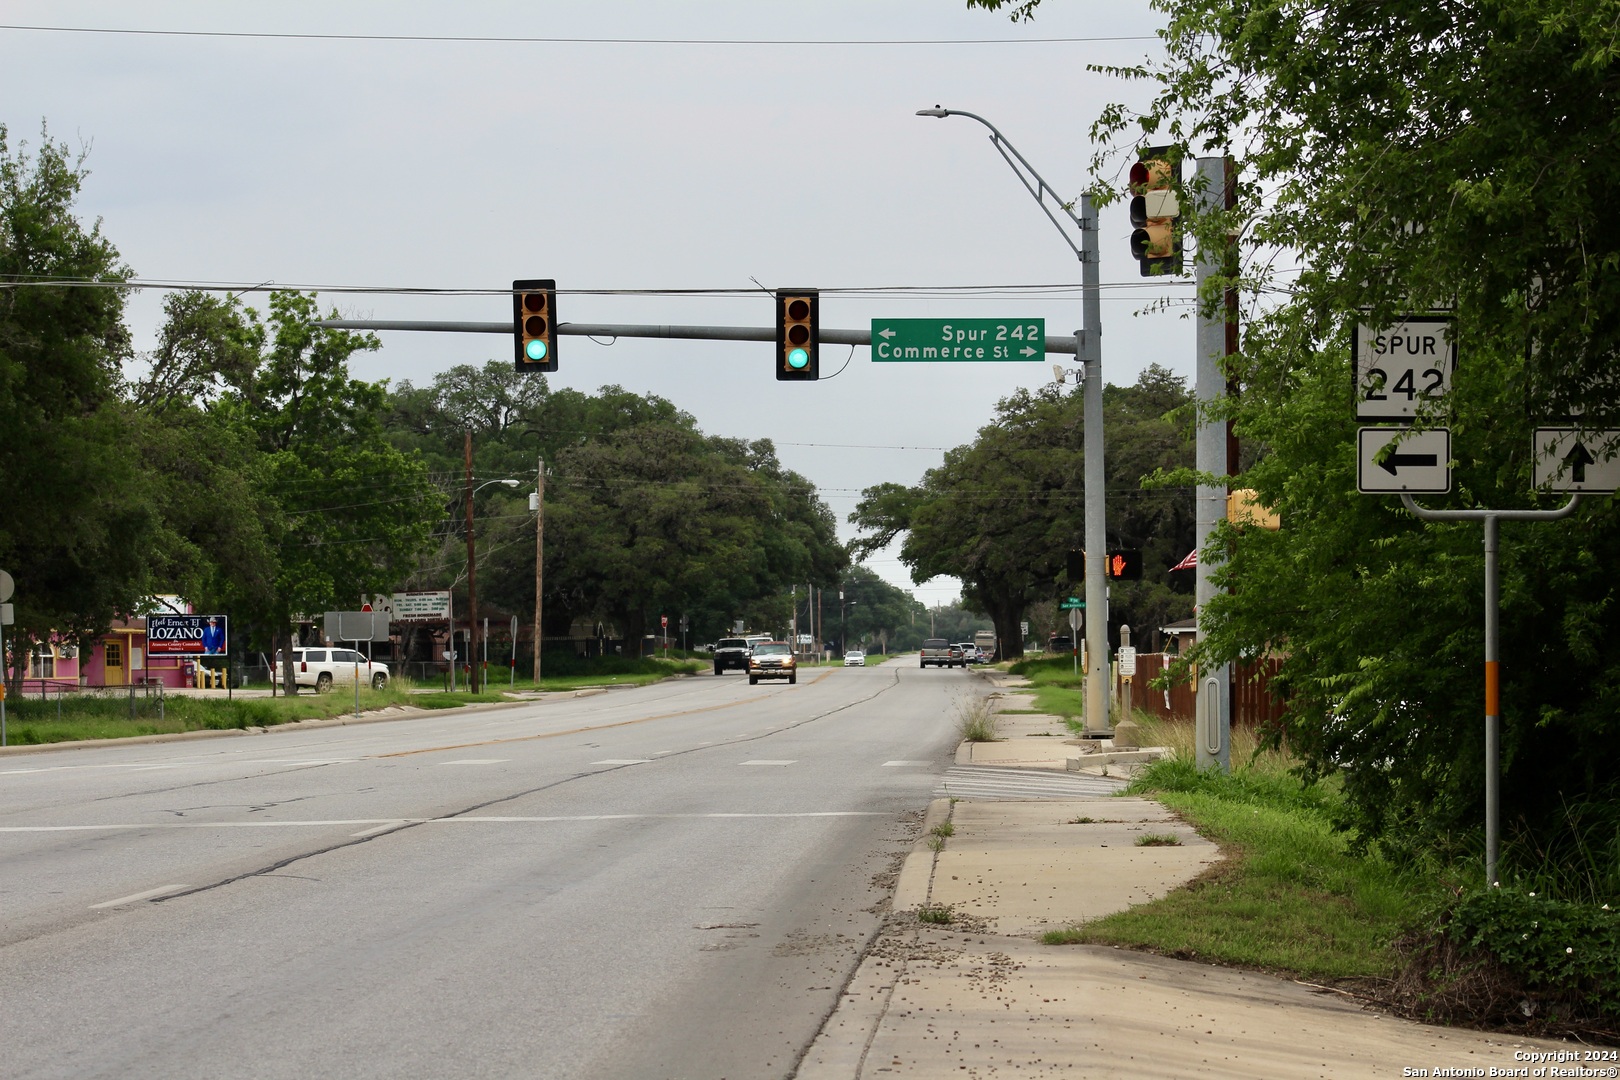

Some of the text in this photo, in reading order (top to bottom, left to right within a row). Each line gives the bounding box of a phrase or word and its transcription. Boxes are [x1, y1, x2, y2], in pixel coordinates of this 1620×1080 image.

[942, 325, 1038, 343] Spur 242
[878, 342, 1008, 358] Commerce St
[1365, 336, 1443, 401] SPUR 242
[149, 627, 204, 639] LOZANO
